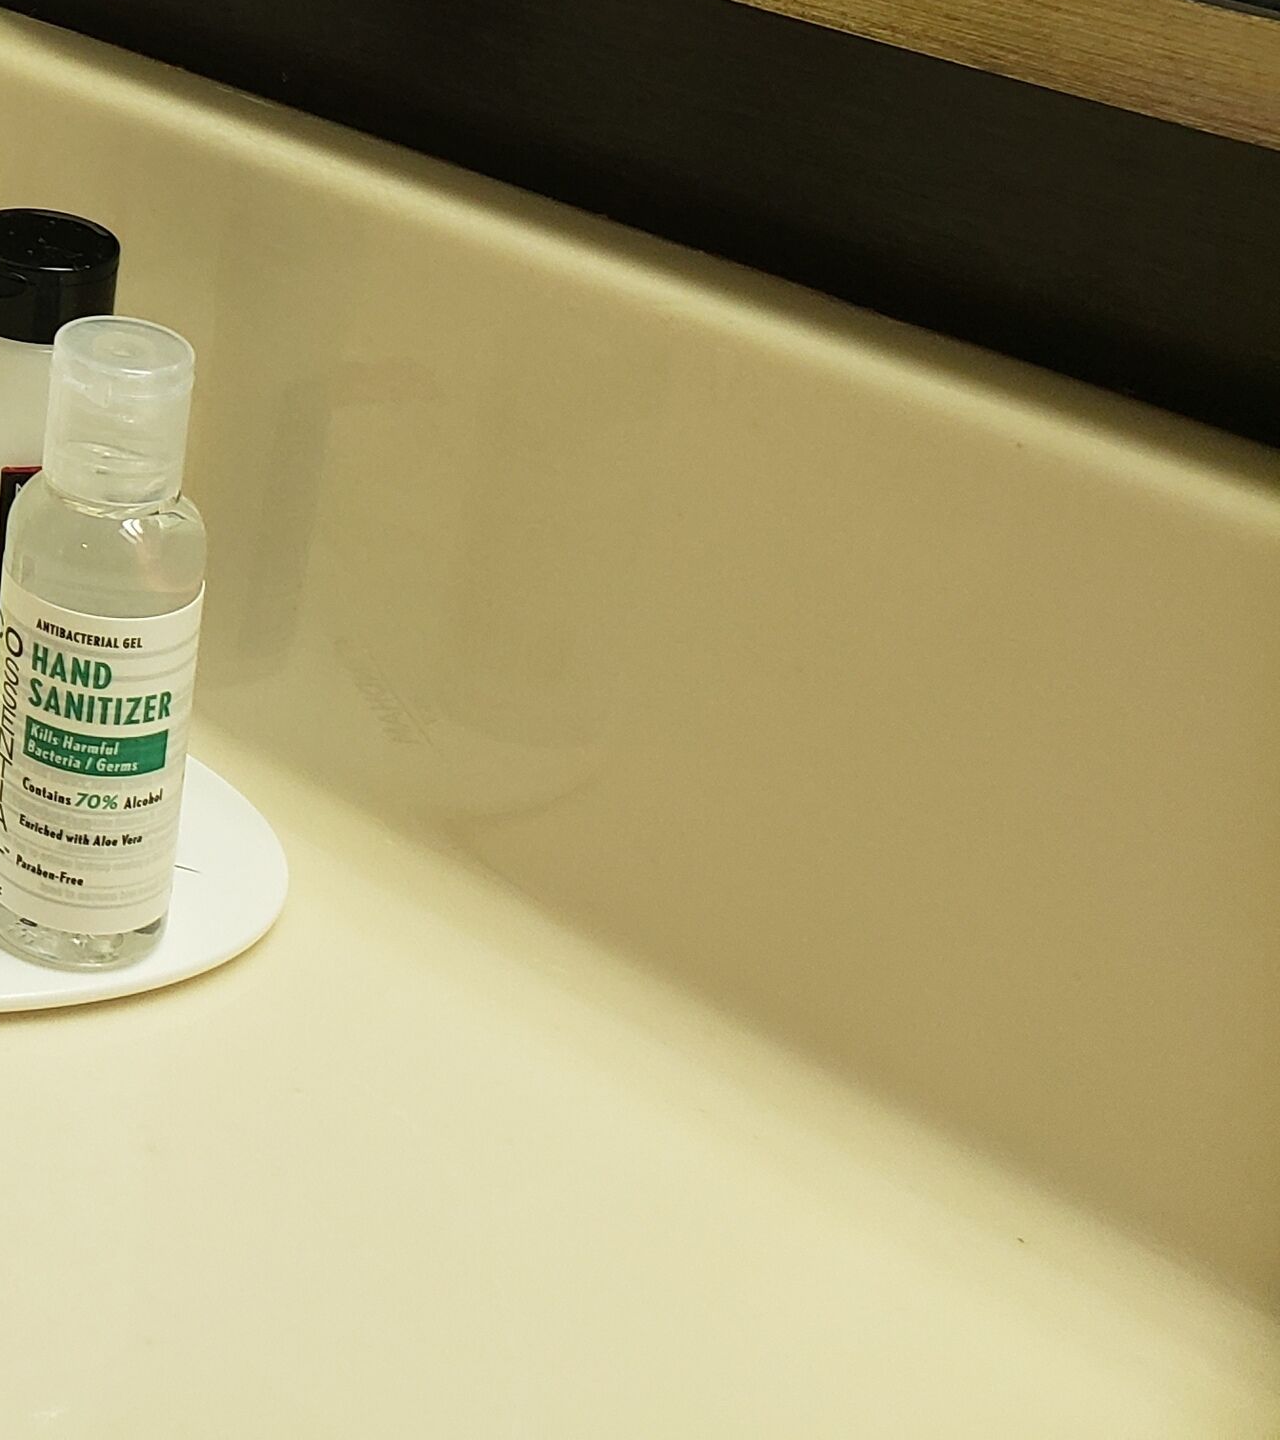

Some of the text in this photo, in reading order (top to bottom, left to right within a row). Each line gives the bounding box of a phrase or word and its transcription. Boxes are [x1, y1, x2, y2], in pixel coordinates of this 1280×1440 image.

[36, 618, 143, 649] ANTIBACTERIAL GEL
[32, 642, 112, 690] HAND
[28, 678, 172, 726] SANITIZER
[27, 739, 138, 772] Bacteria / Germs
[31, 725, 119, 755] Kills Harmful
[22, 777, 163, 810] Contains 70% Alcohol
[19, 813, 63, 841] Enriched
[66, 834, 90, 846] with
[92, 834, 118, 847] Aloe
[122, 834, 142, 845] Vera
[15, 854, 84, 886] Paraben-Free
